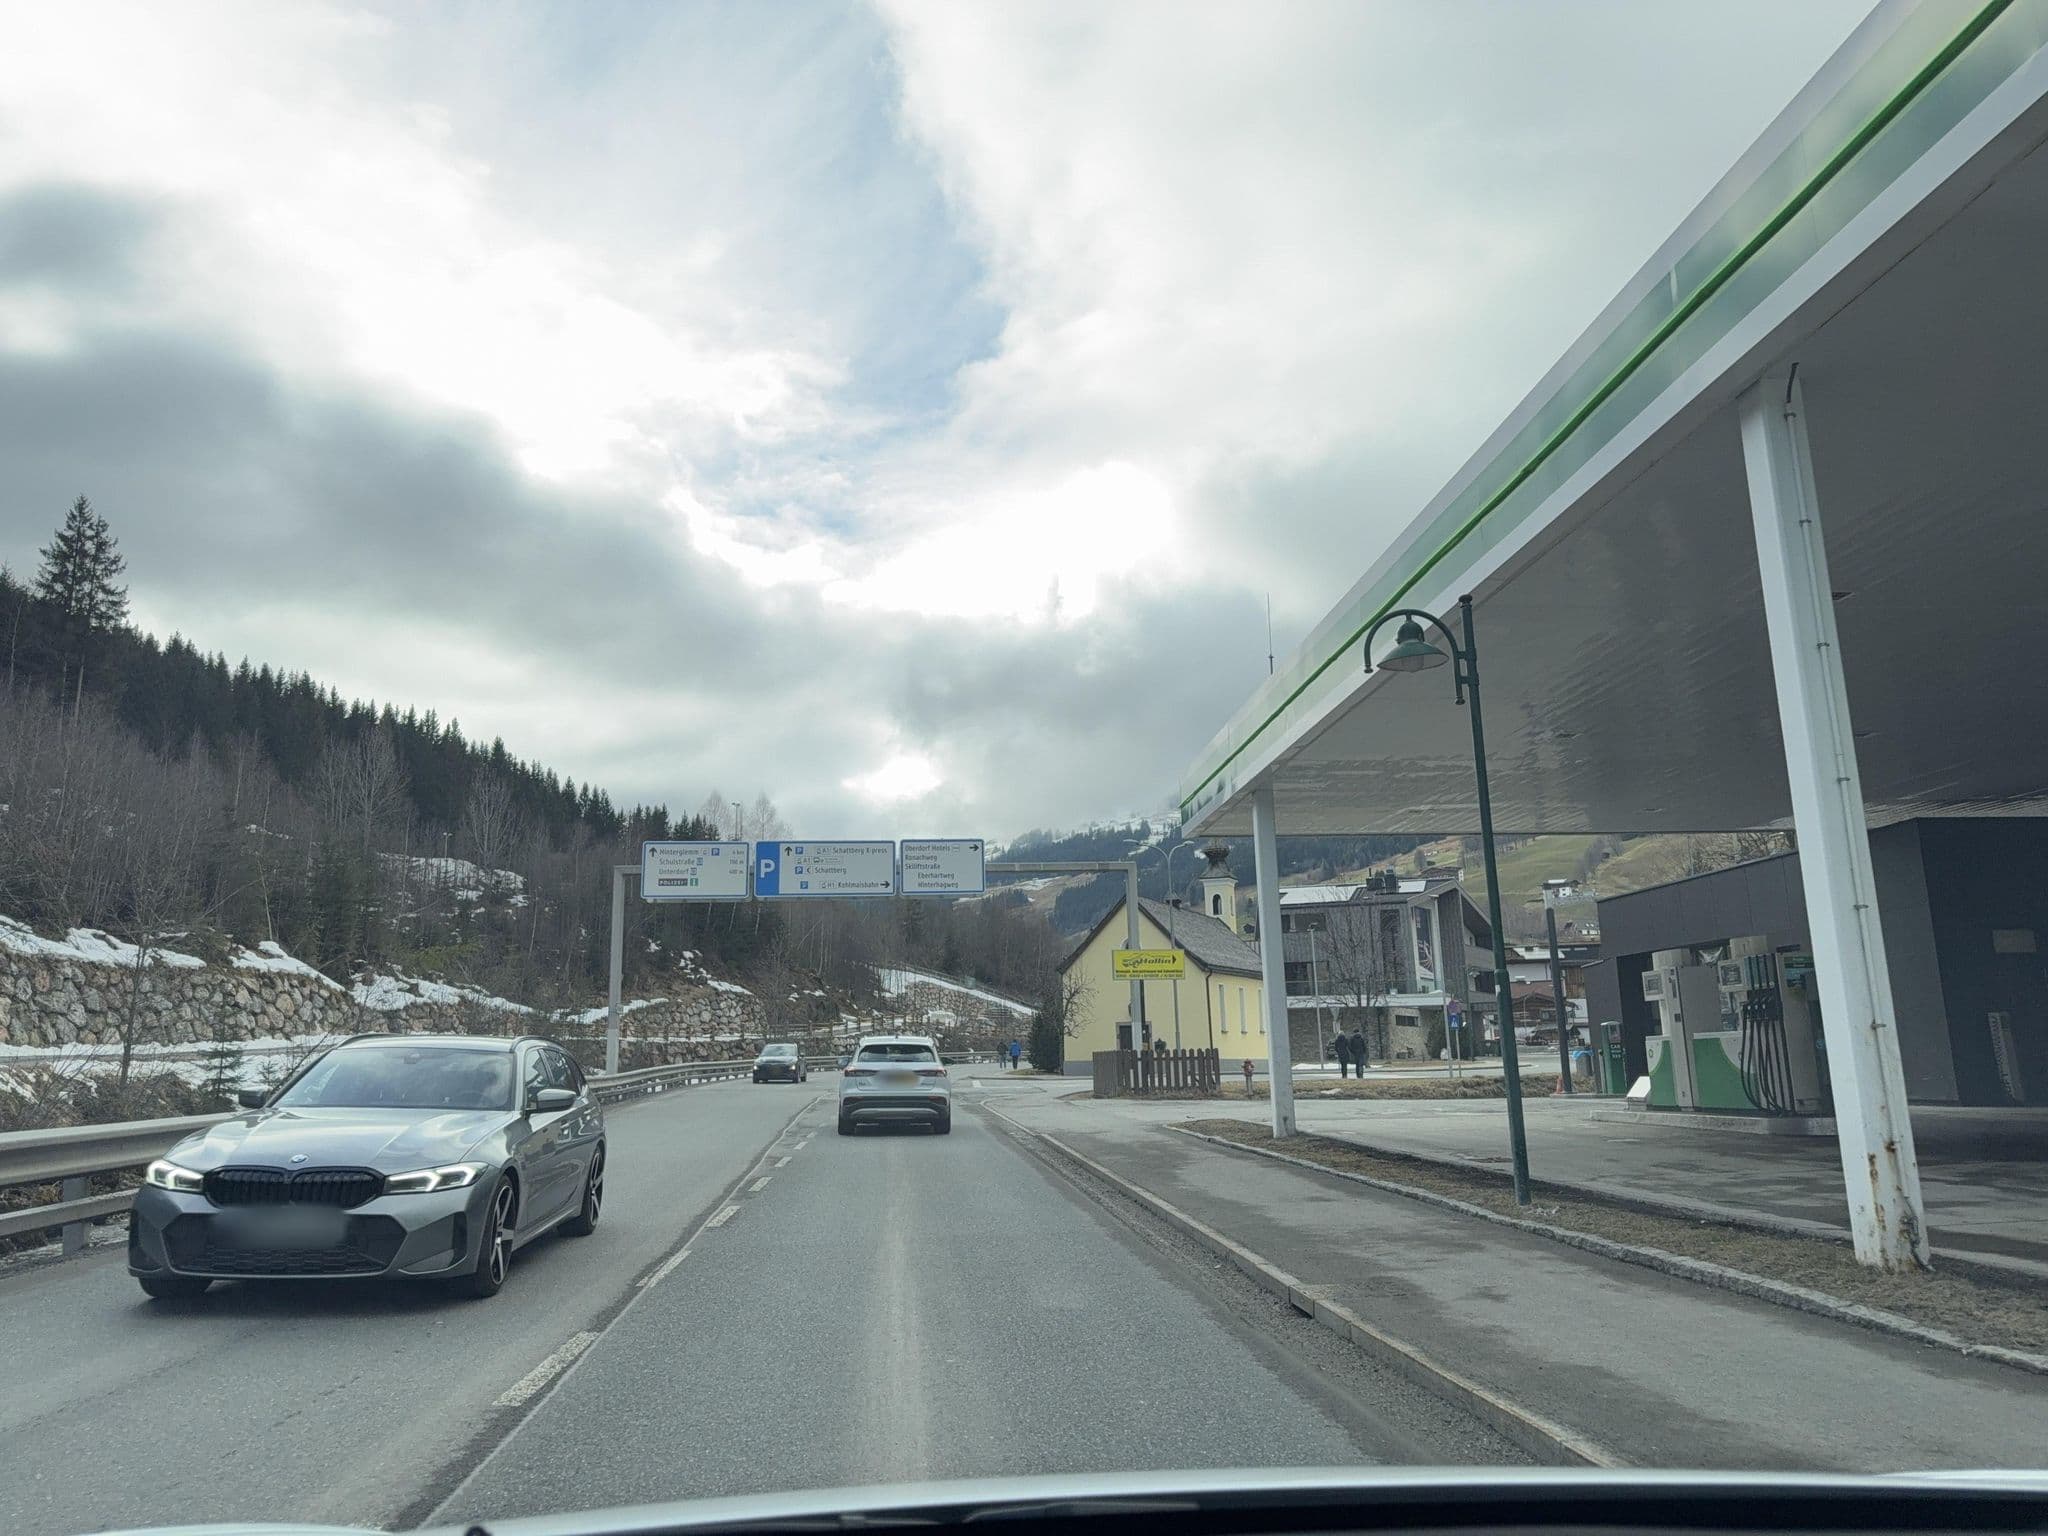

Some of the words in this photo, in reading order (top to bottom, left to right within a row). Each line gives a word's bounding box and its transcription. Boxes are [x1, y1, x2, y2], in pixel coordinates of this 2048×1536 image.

[832, 846, 865, 855] Schattberg
[759, 858, 776, 878] P
[814, 866, 847, 875] Schattberg
